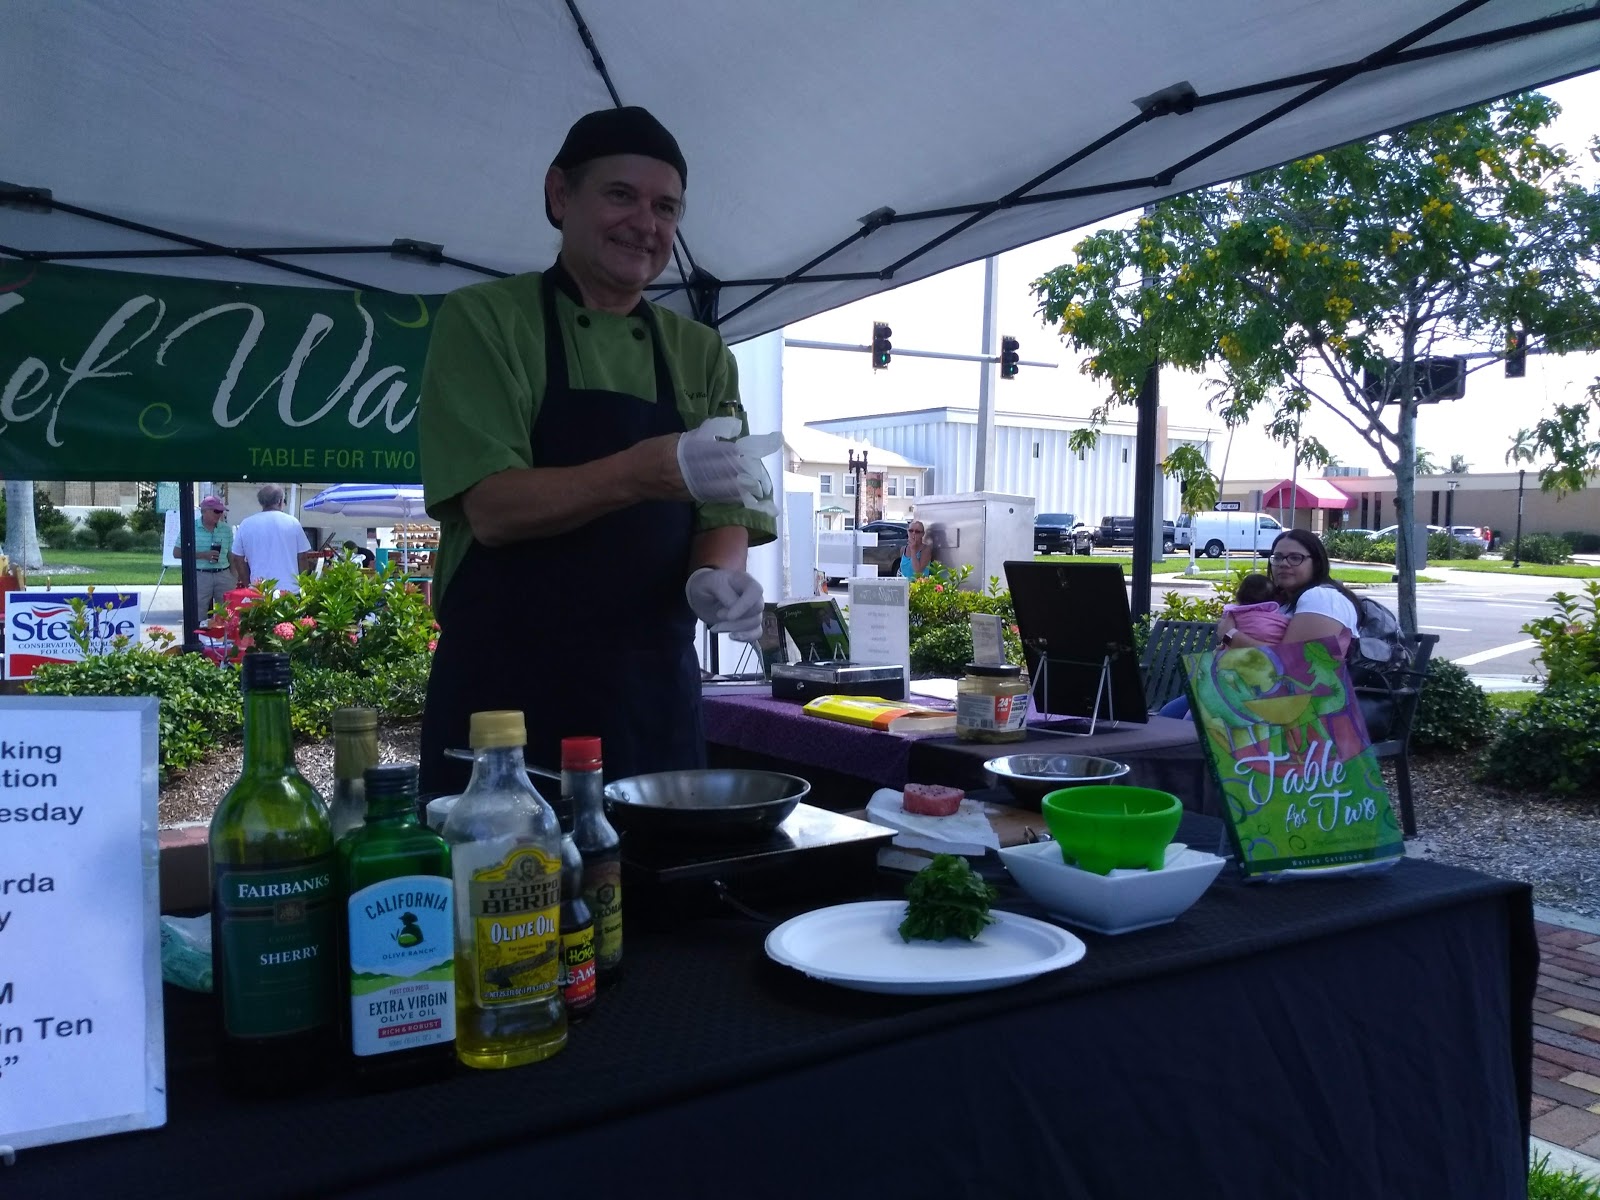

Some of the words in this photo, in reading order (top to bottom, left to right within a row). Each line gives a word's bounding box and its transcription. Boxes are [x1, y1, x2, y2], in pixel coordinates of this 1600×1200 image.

[157, 296, 421, 434] Wa
[248, 448, 315, 468] TABLE
[324, 449, 364, 468] FOR
[372, 450, 416, 469] TWO
[1, 741, 62, 764] king
[2, 769, 58, 788] tion
[1234, 740, 1347, 806] Table
[0, 802, 84, 825] esday
[1285, 804, 1309, 833] for
[1307, 789, 1378, 832] Two
[238, 873, 330, 899] FAIRBANKS
[488, 879, 558, 899] FILIPPO
[365, 892, 448, 920] CALIFORNIA
[490, 917, 534, 945] OLIVE
[536, 914, 556, 937] OIL
[260, 944, 319, 966] SHERRY
[383, 952, 405, 960] OLIVE
[408, 948, 434, 957] RANCH
[389, 987, 402, 996] FIRST
[403, 985, 415, 993] COLD
[415, 983, 430, 992] PRESS
[369, 998, 405, 1016] EXTRA
[408, 991, 448, 1010] VIRGIN
[381, 1012, 414, 1024] OLIVE
[418, 1008, 437, 1017] OIL
[33, 1016, 93, 1040] Ten
[381, 1028, 401, 1036] RICH
[408, 1022, 438, 1031] ROBUST
